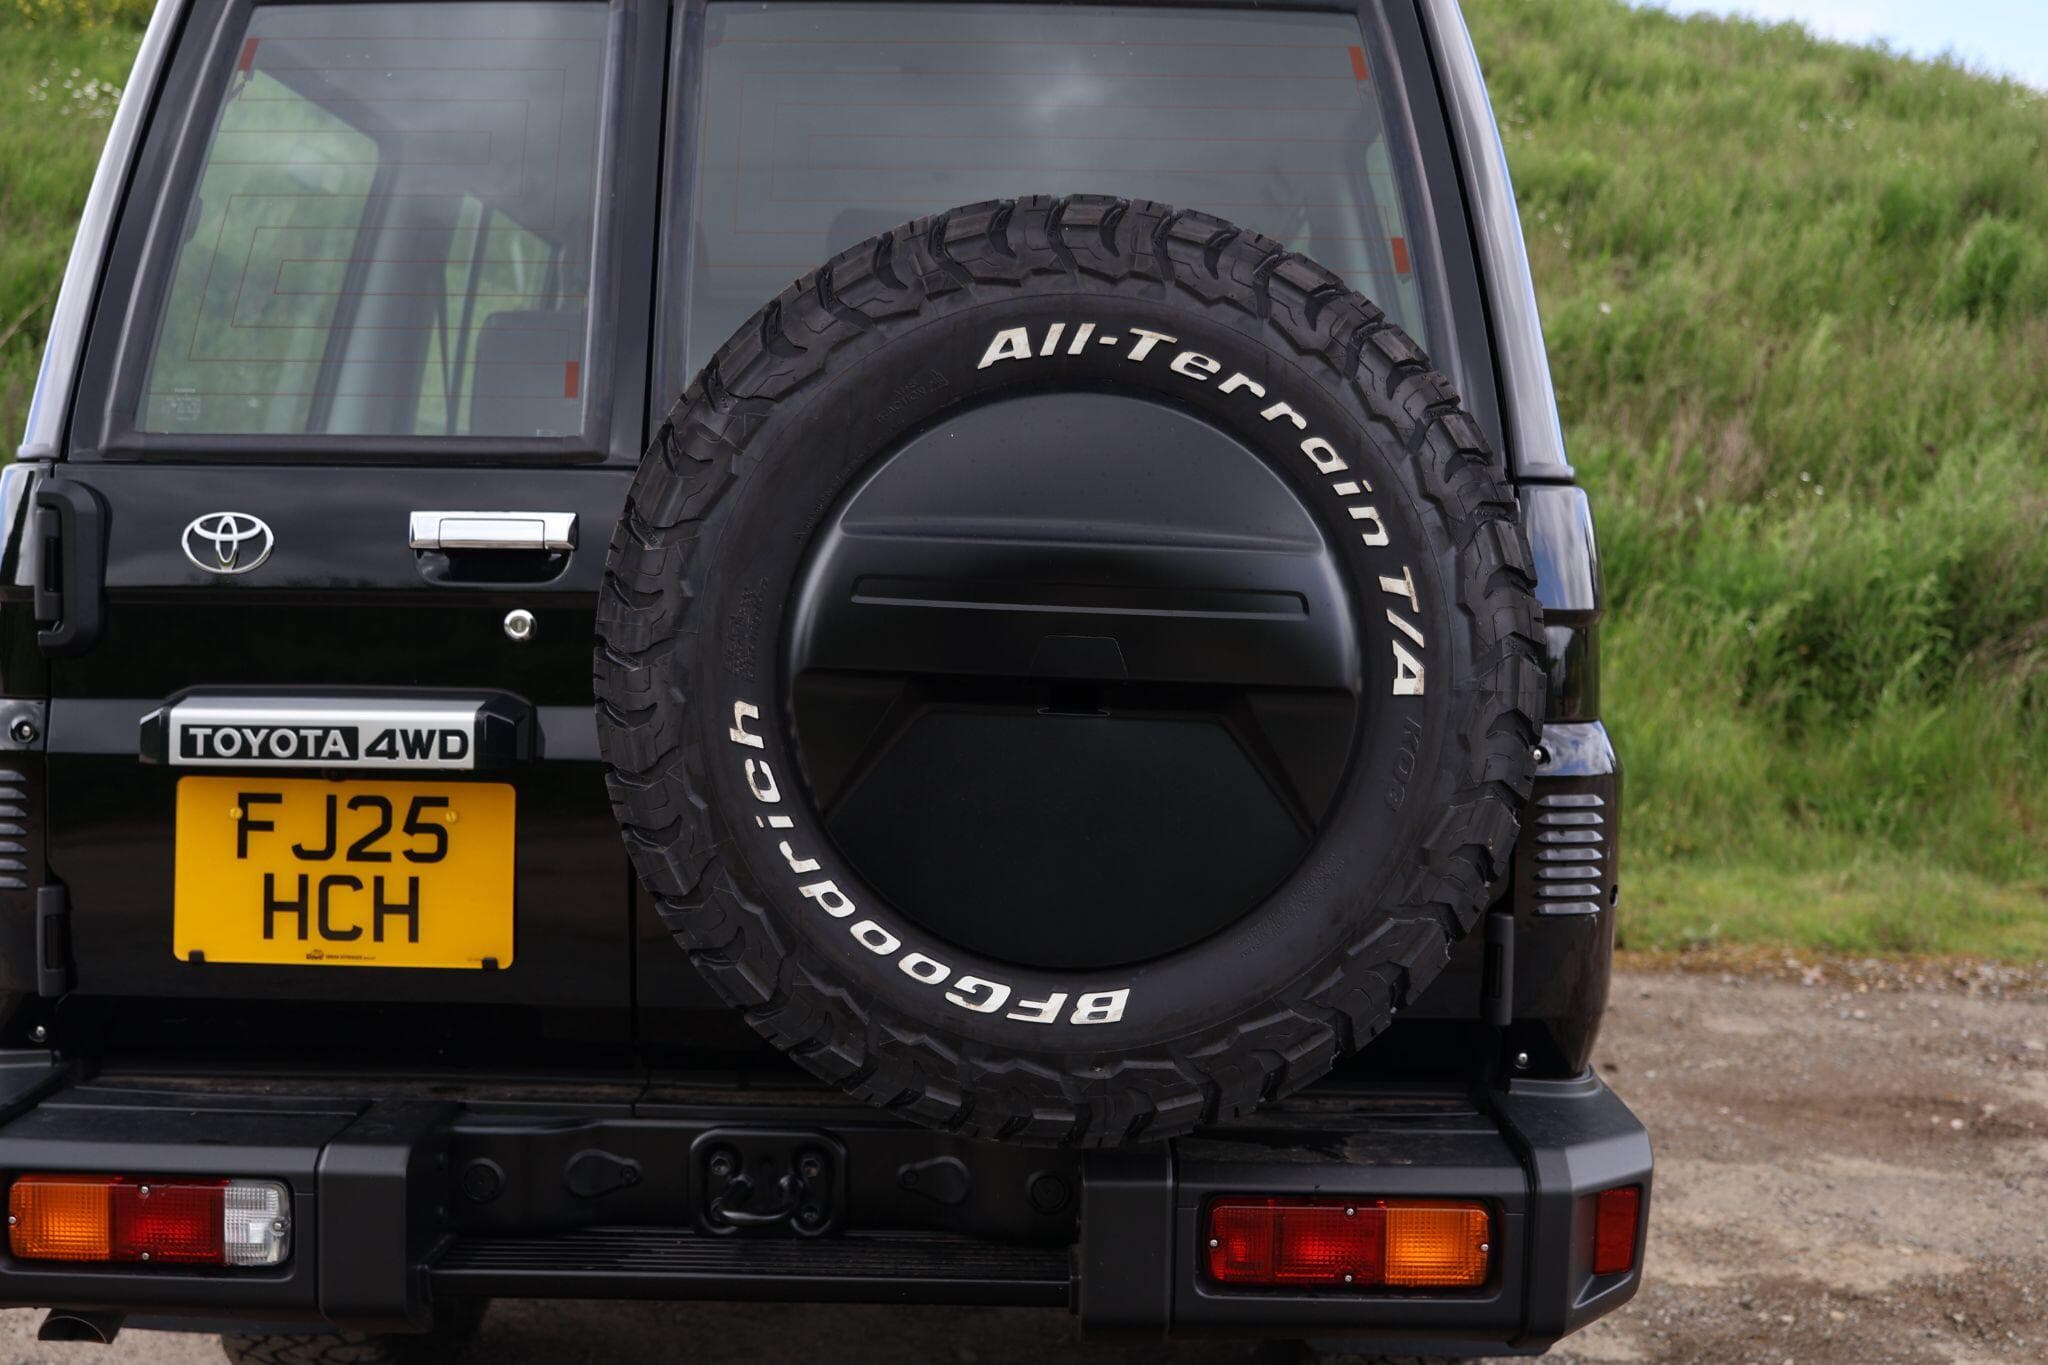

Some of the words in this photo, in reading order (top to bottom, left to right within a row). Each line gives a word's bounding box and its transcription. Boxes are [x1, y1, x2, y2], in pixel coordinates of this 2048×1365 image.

[977, 322, 1390, 547] All-Terrain
[1378, 565, 1425, 697] T/A
[188, 727, 351, 759] TOYOTA
[365, 728, 469, 760] 4WD
[236, 791, 450, 864] FJ25
[729, 700, 1131, 1025] BFGoodrich
[263, 872, 420, 943] HCH
